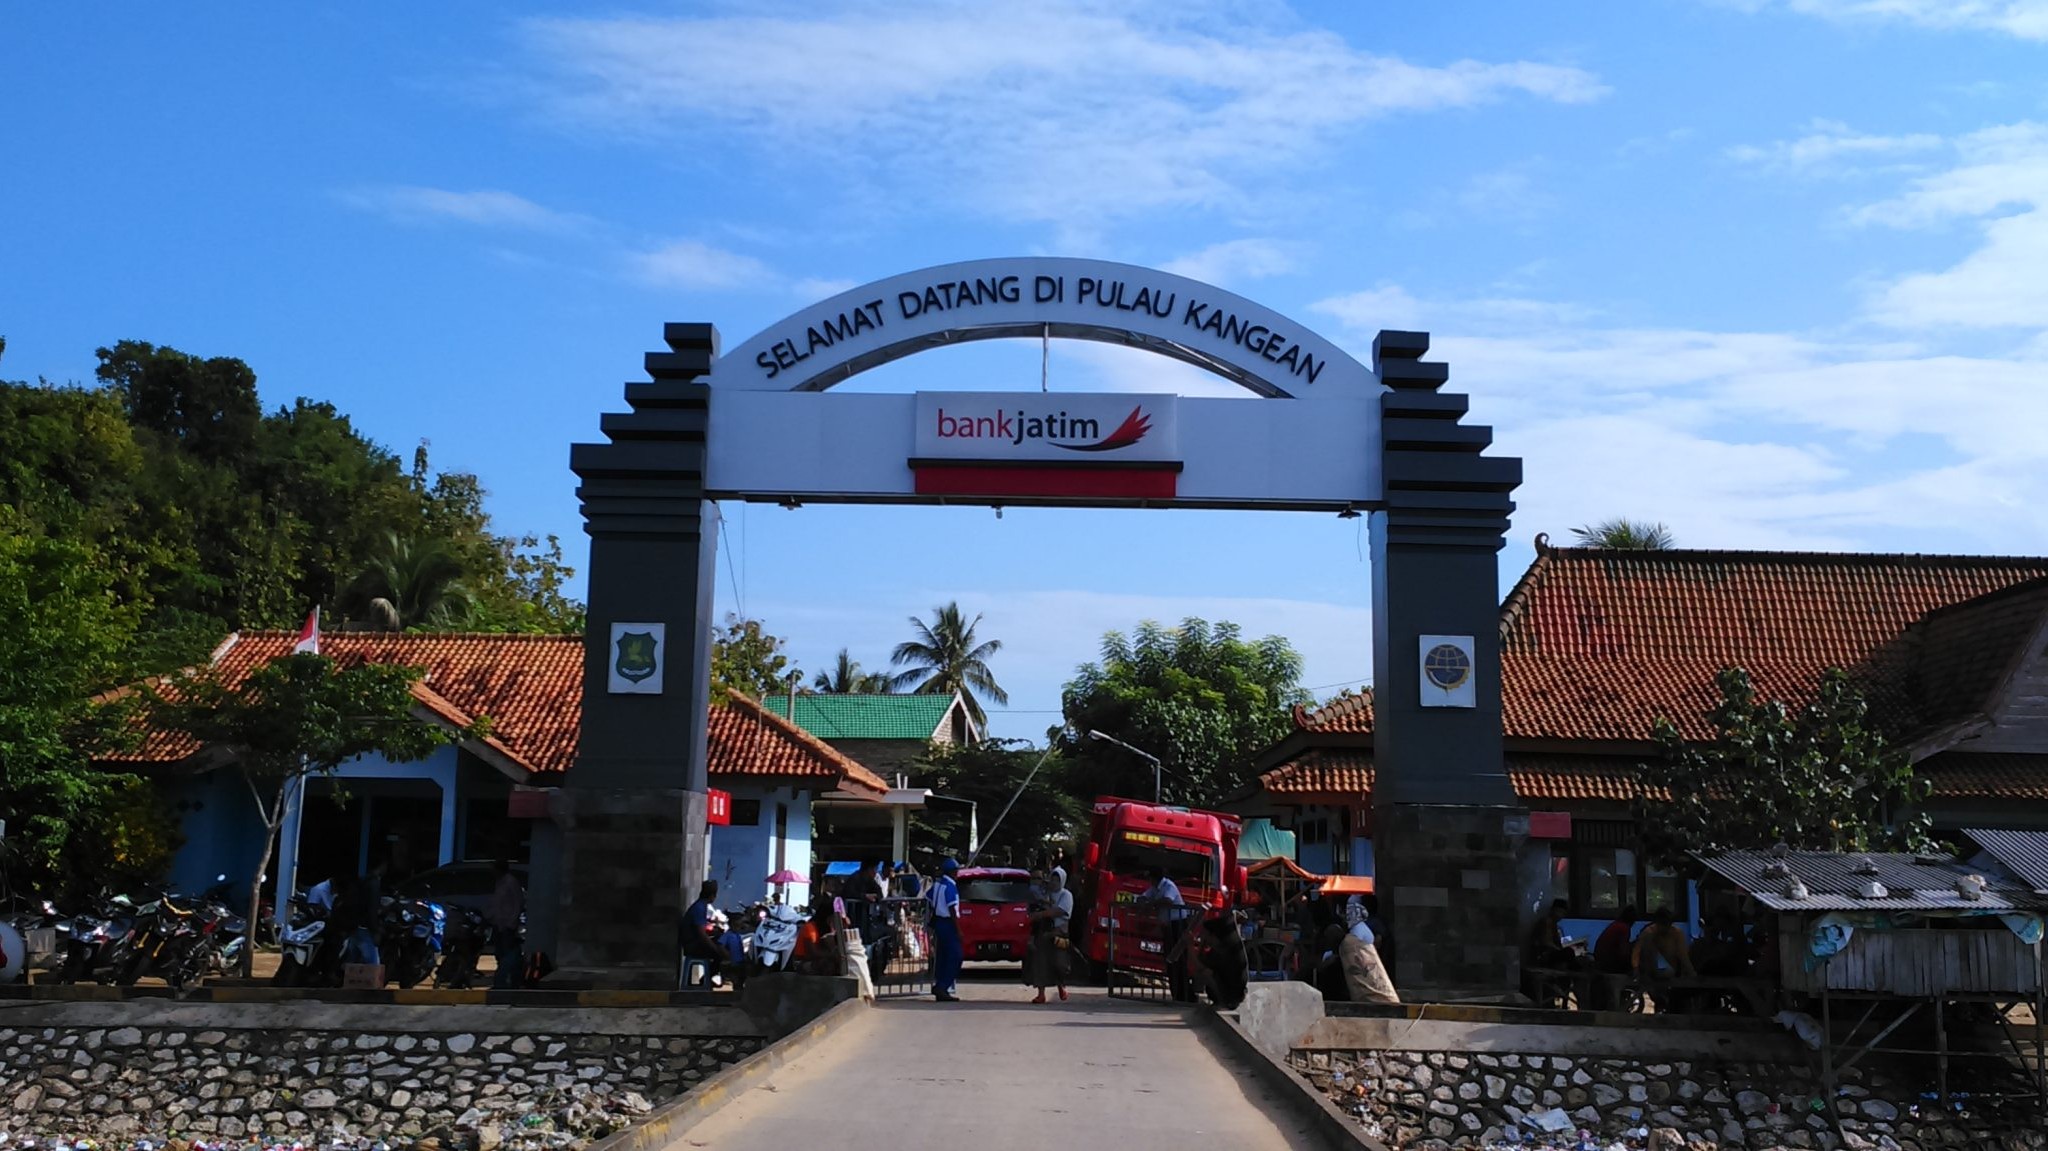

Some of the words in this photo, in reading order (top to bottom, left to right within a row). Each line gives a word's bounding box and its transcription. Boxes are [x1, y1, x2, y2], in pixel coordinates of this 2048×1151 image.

[756, 299, 884, 379] SELAMAT
[897, 275, 1020, 320] DATANG
[1034, 275, 1064, 304] DI
[1077, 277, 1176, 319] PULAU
[1183, 299, 1326, 385] KANGEAN
